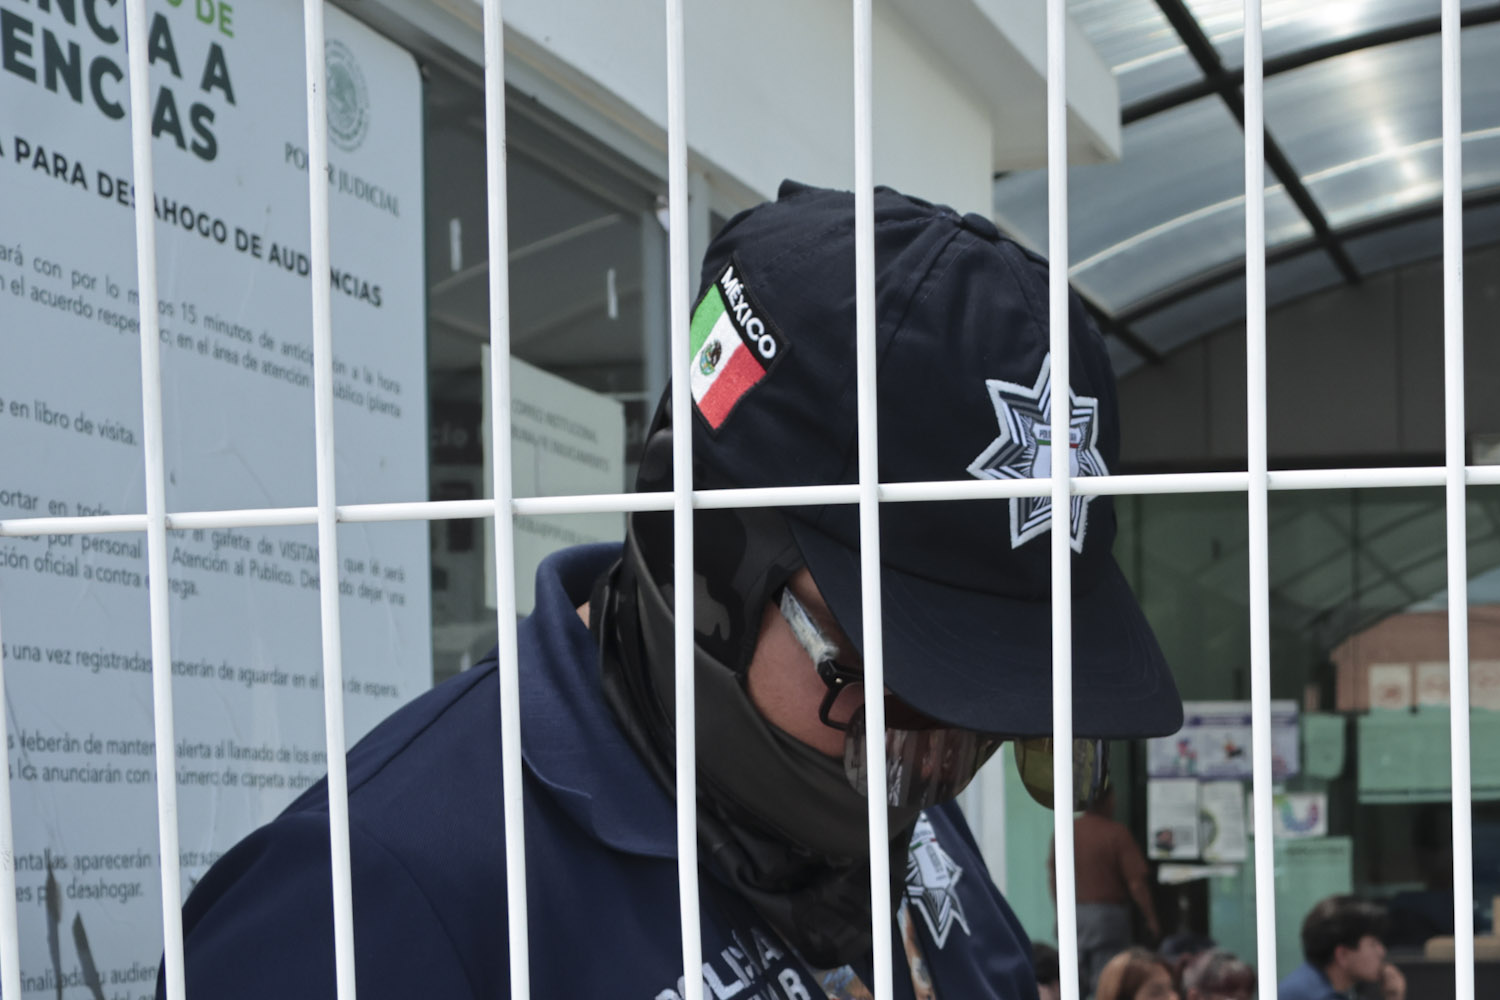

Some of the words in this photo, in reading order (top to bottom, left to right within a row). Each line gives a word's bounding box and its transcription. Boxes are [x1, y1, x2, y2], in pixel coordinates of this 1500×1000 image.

[0, 8, 219, 162] ENCAS
[201, 41, 236, 107] A
[14, 136, 88, 190] PARA
[235, 228, 263, 259] DE
[268, 242, 383, 308] AUDNCIAS
[30, 284, 94, 320] acuerdo
[33, 257, 62, 280] con
[71, 269, 97, 291] por
[105, 274, 120, 299] lo
[181, 301, 196, 326] 15
[721, 265, 776, 359] MÉXICO
[9, 401, 30, 419] en
[34, 399, 71, 430] libro
[74, 411, 95, 436] de
[81, 535, 143, 560] personal
[34, 552, 79, 579] oficial
[96, 567, 142, 589] contra
[12, 645, 41, 663] una
[45, 647, 72, 667] vez
[73, 849, 151, 874] aparecerán
[66, 877, 144, 904] desahogar.
